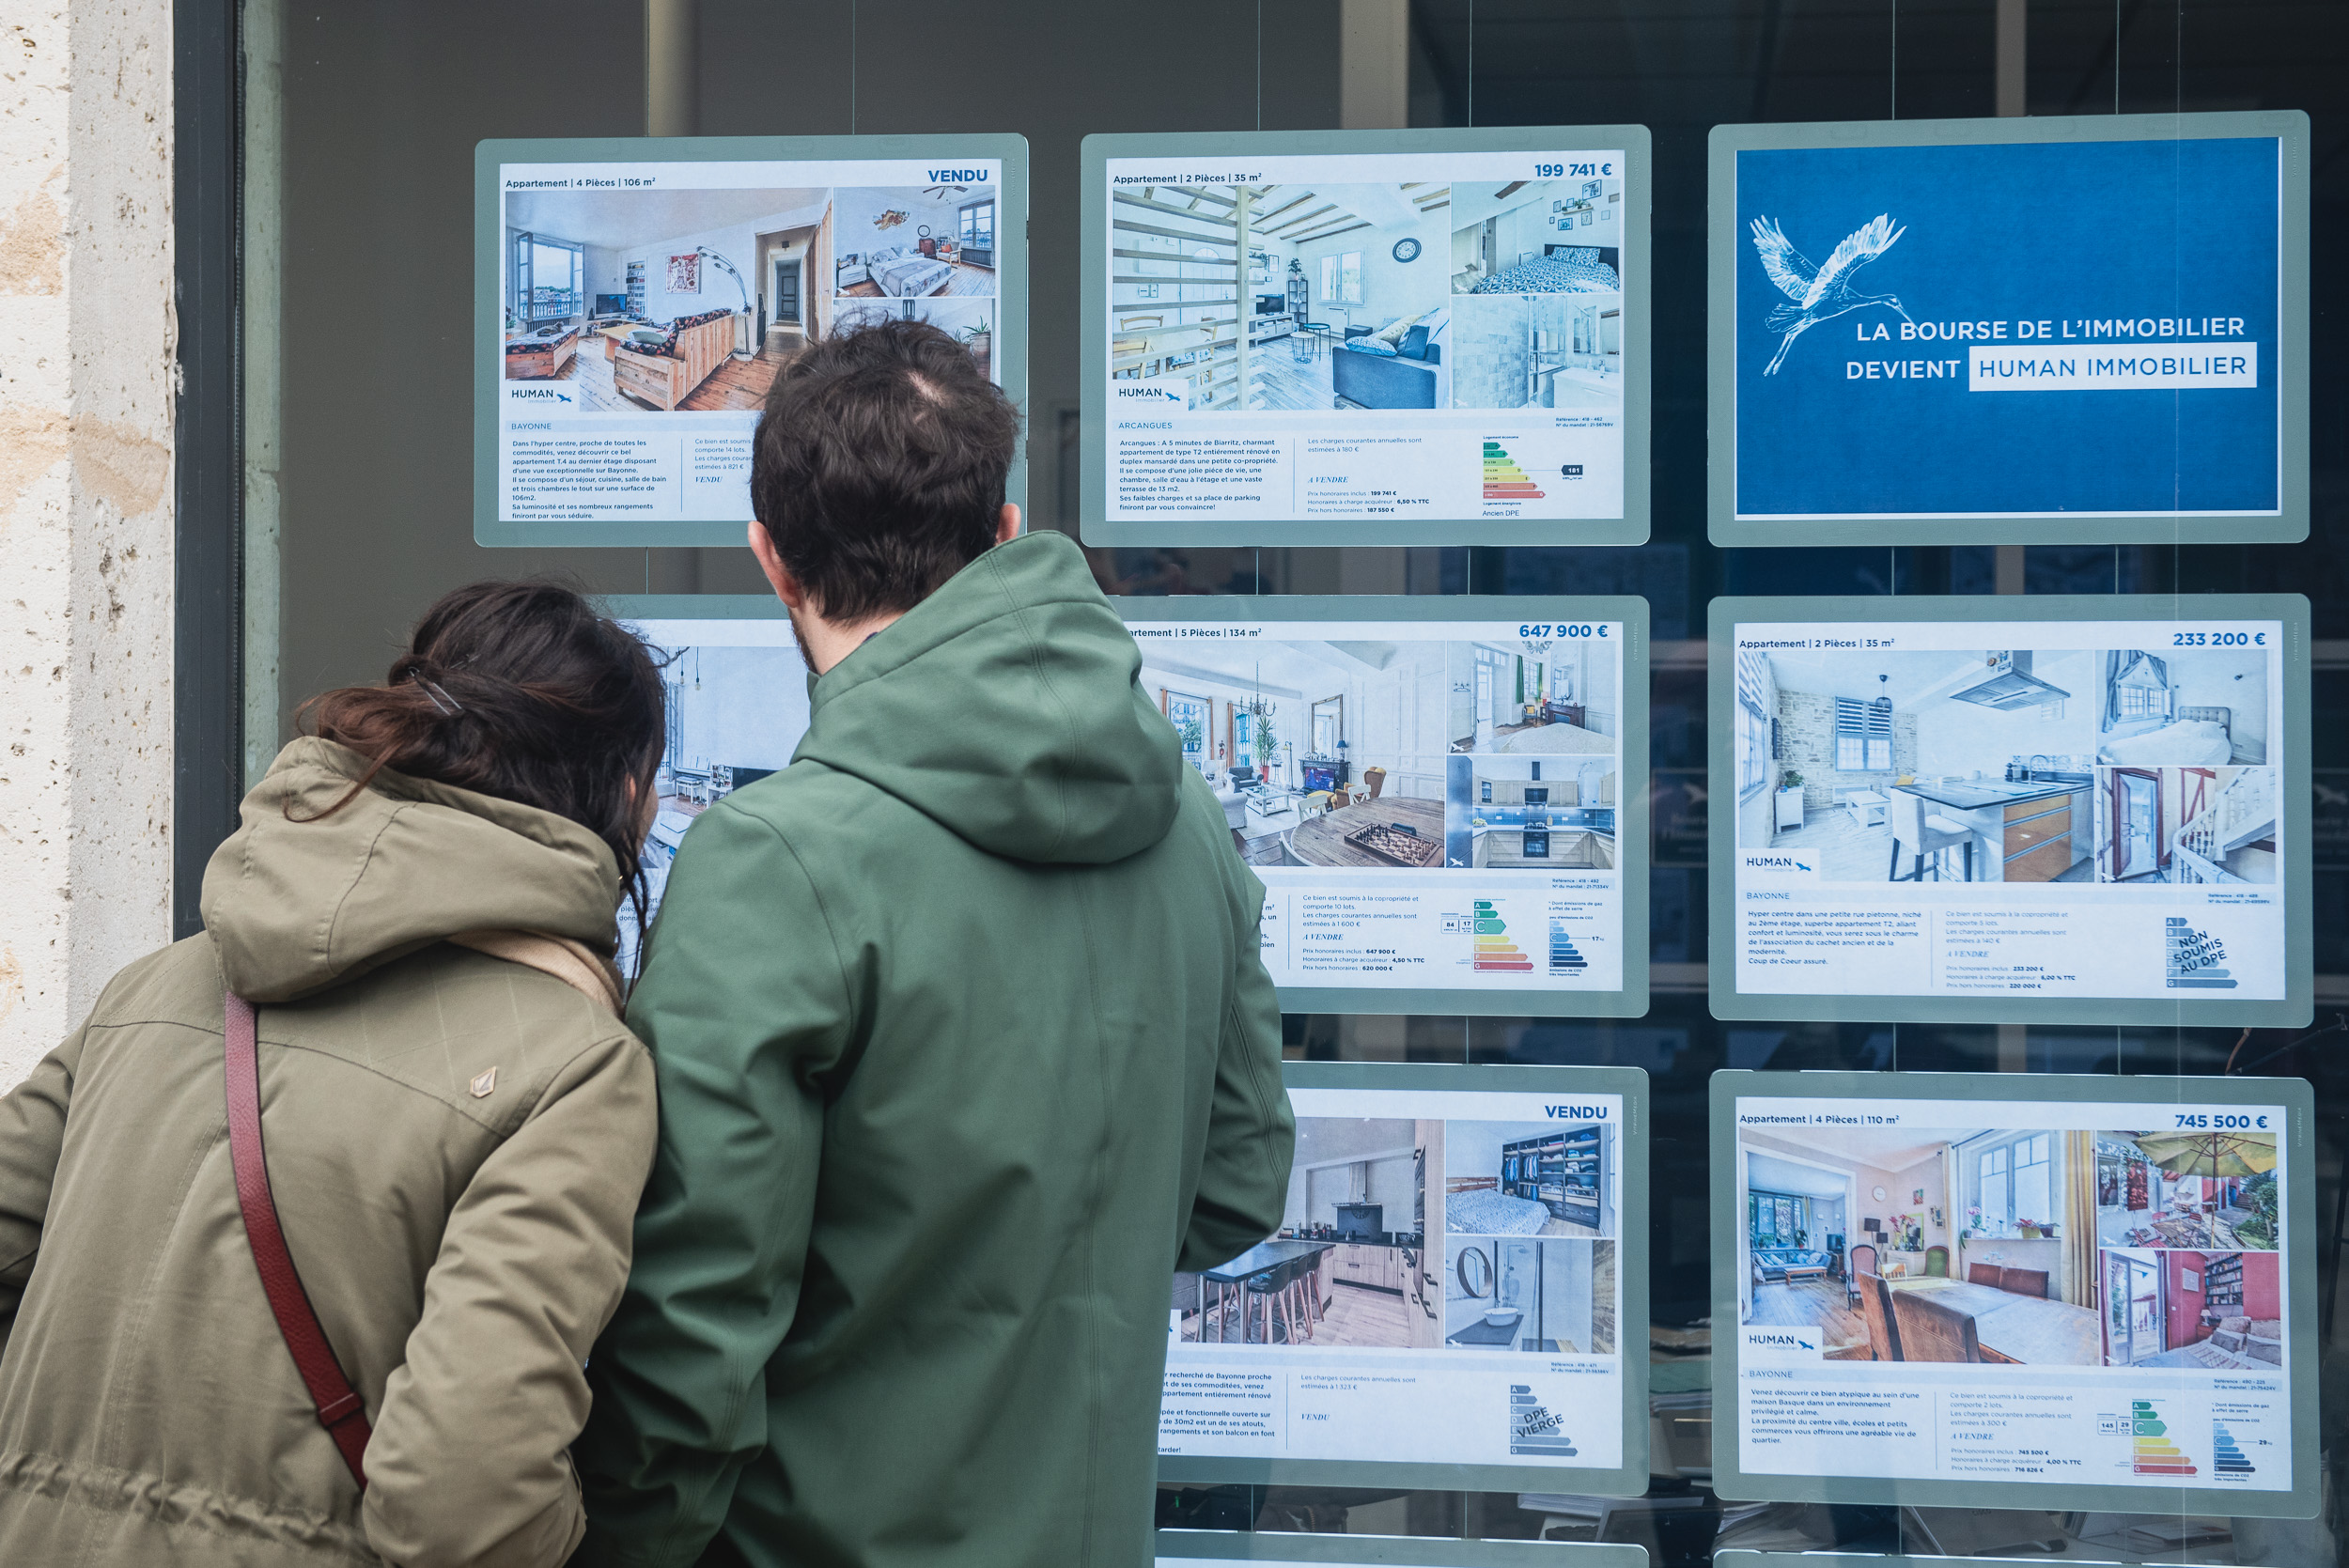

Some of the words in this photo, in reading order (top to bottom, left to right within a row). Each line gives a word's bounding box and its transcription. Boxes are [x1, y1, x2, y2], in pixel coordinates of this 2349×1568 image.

[928, 170, 988, 182] VENDU
[1534, 164, 1563, 178] 199
[1569, 163, 1595, 177] 741
[1601, 163, 1612, 176] €
[506, 180, 568, 189] Appartement
[586, 179, 615, 187] Pièces
[644, 178, 656, 186] m²
[1113, 176, 1177, 184] Appartement
[1195, 174, 1225, 182] Pièces
[1235, 173, 1246, 182] 35
[1250, 173, 1262, 181] m²
[1858, 323, 1890, 341] LA
[1901, 322, 2008, 340] BOURSE
[2018, 320, 2052, 338] DE
[2063, 318, 2244, 337] L'IMMOBILIER
[1847, 361, 1961, 380] DEVIENT
[1981, 360, 2075, 378] HUMAN
[2088, 357, 2246, 376] IMMOBILIER
[511, 389, 553, 398] HUMAN
[1190, 629, 1221, 637] Pièces
[1250, 629, 1262, 637] m²
[1519, 625, 1551, 638] 647
[1556, 625, 1592, 638] 900
[1597, 625, 1609, 638] €
[1739, 641, 1806, 649] Appartement
[1825, 639, 1857, 647] Pièces
[2173, 633, 2206, 646] 233
[2212, 632, 2248, 645] 200
[2254, 632, 2265, 645] €
[1747, 858, 1792, 866] HUMAN
[2178, 930, 2208, 948] NON
[2173, 939, 2223, 963] SOUMIS
[2181, 960, 2198, 974] AU
[2201, 950, 2227, 966] DPE
[1545, 1106, 1608, 1119] VENDU
[1740, 1115, 1806, 1125] Appartement
[1826, 1115, 1859, 1124] Pièces
[1868, 1116, 1883, 1125] 110
[1886, 1115, 1900, 1124] m²
[2175, 1115, 2208, 1128] 745
[2214, 1115, 2250, 1128] 500
[2256, 1116, 2268, 1129] €
[1750, 1335, 1795, 1344] HUMAN
[1524, 1406, 1549, 1423] DPE
[1517, 1413, 1564, 1438] VIERGE
